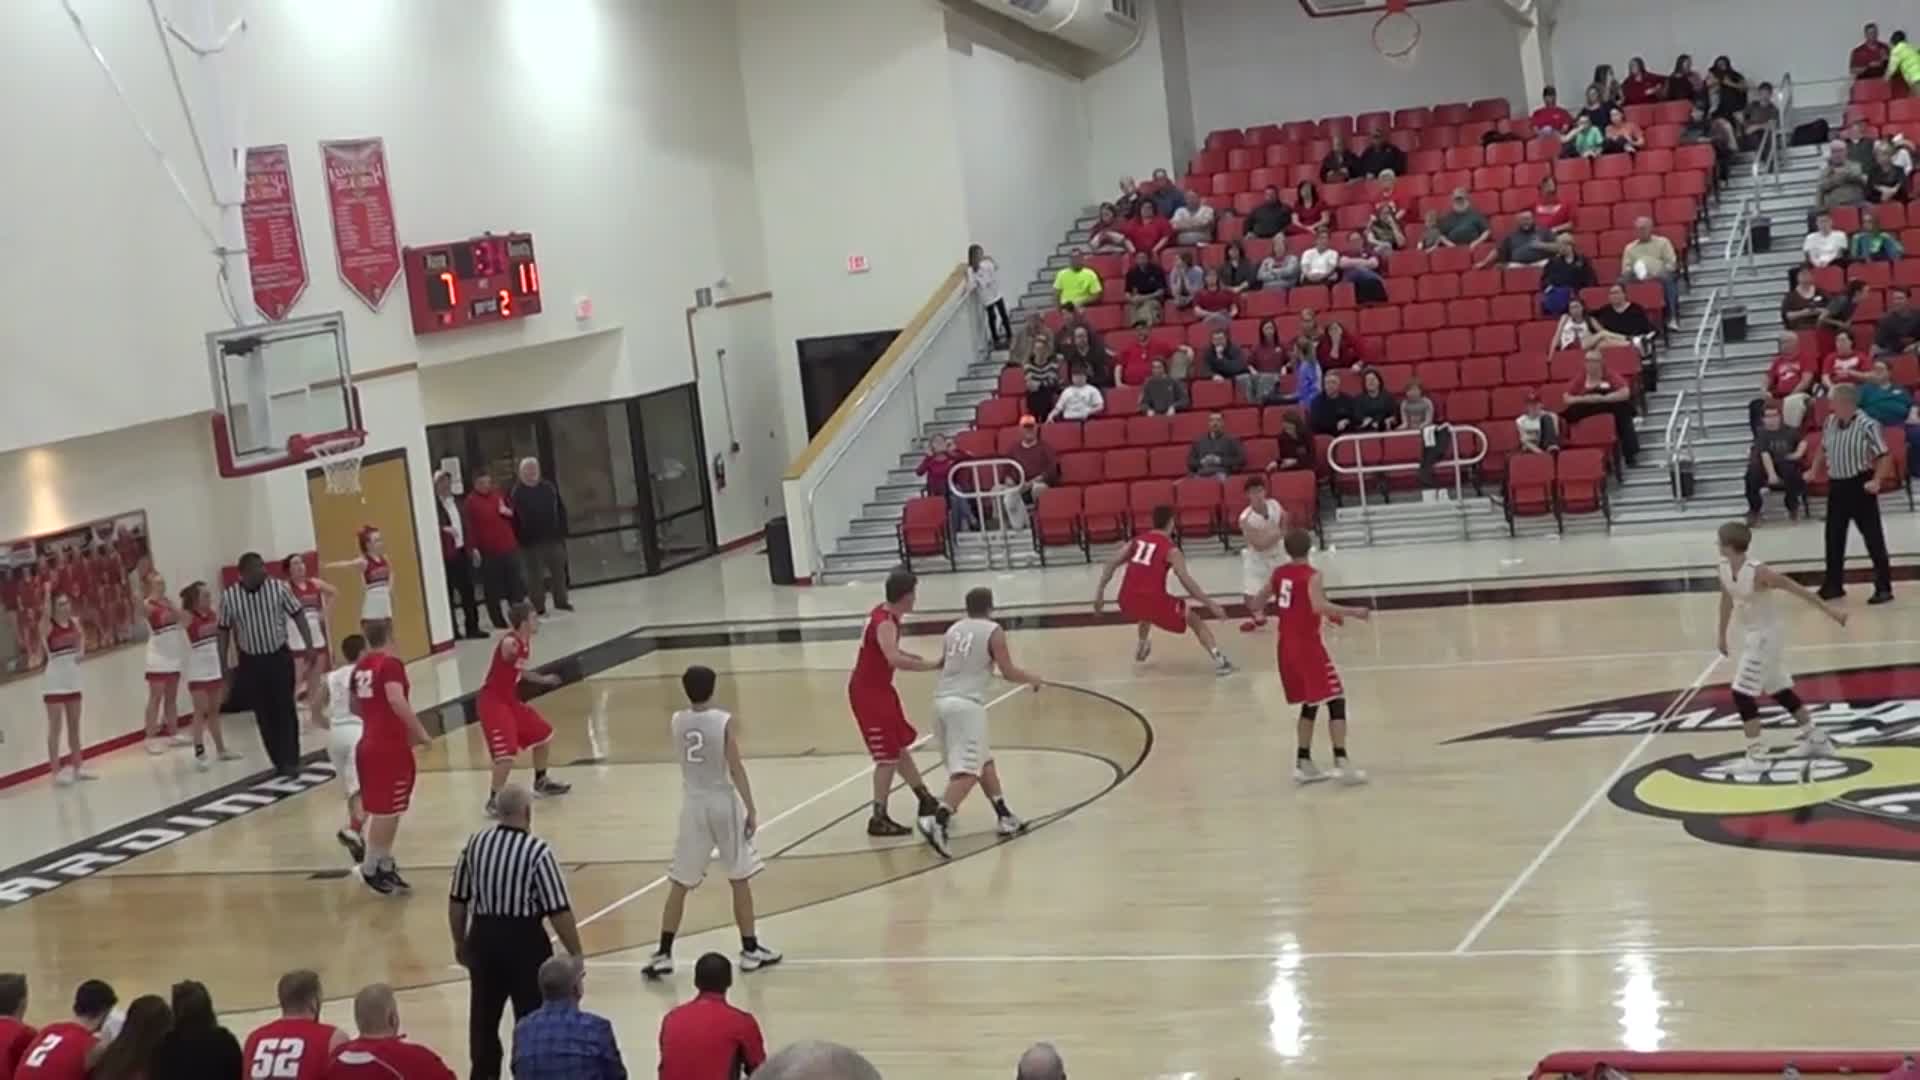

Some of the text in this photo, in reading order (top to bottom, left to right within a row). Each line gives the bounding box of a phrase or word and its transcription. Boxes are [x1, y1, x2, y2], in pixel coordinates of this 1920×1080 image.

[440, 271, 457, 306] 7
[518, 262, 538, 294] 11
[499, 289, 512, 317] 2
[1131, 539, 1156, 566] 11
[1278, 578, 1293, 608] 5
[685, 730, 704, 763] 2
[26, 1033, 63, 1068] 2
[250, 1037, 305, 1078] 52
